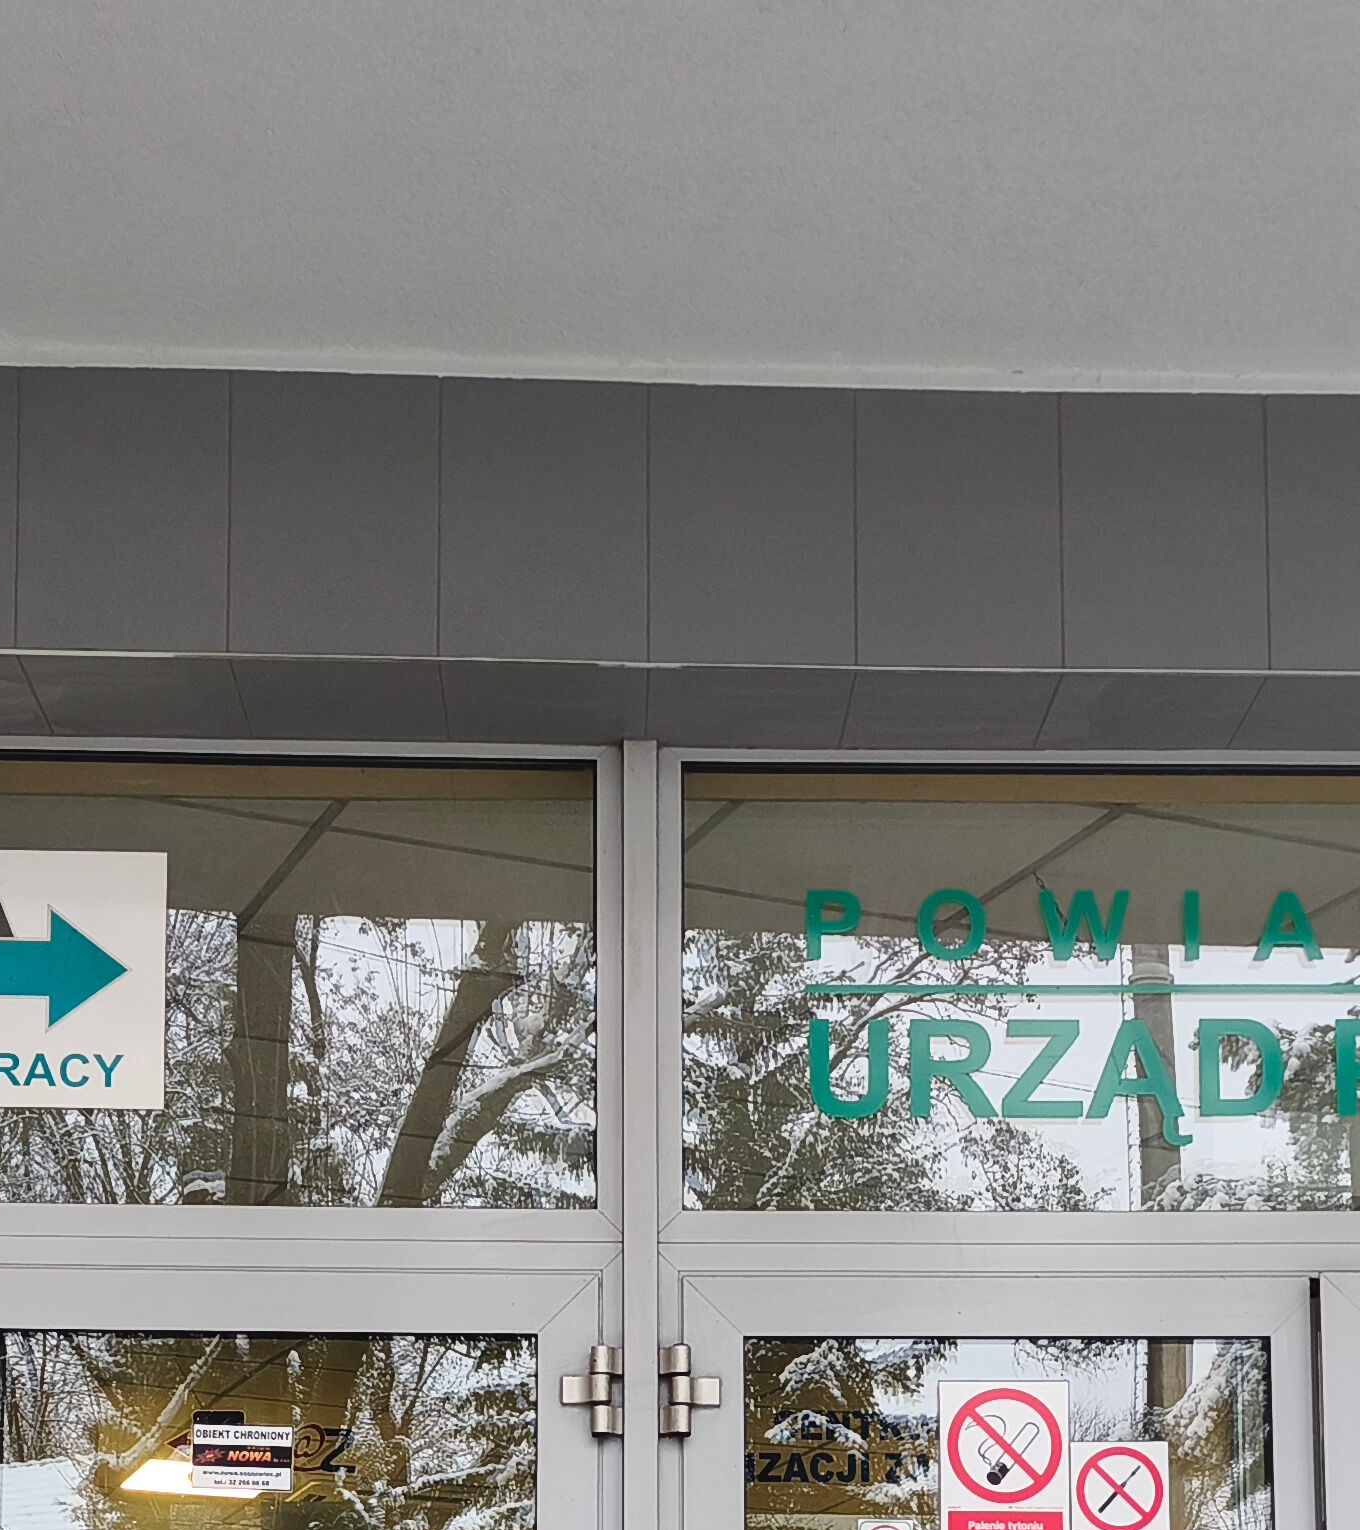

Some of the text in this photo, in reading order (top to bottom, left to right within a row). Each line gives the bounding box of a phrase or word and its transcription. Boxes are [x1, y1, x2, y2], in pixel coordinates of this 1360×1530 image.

[809, 1016, 1282, 1147] URZĄD
[196, 1430, 290, 1441] OBIEKT CHRONIONY
[227, 1451, 272, 1462] NOWA
[968, 1521, 1005, 1530] Palenie
